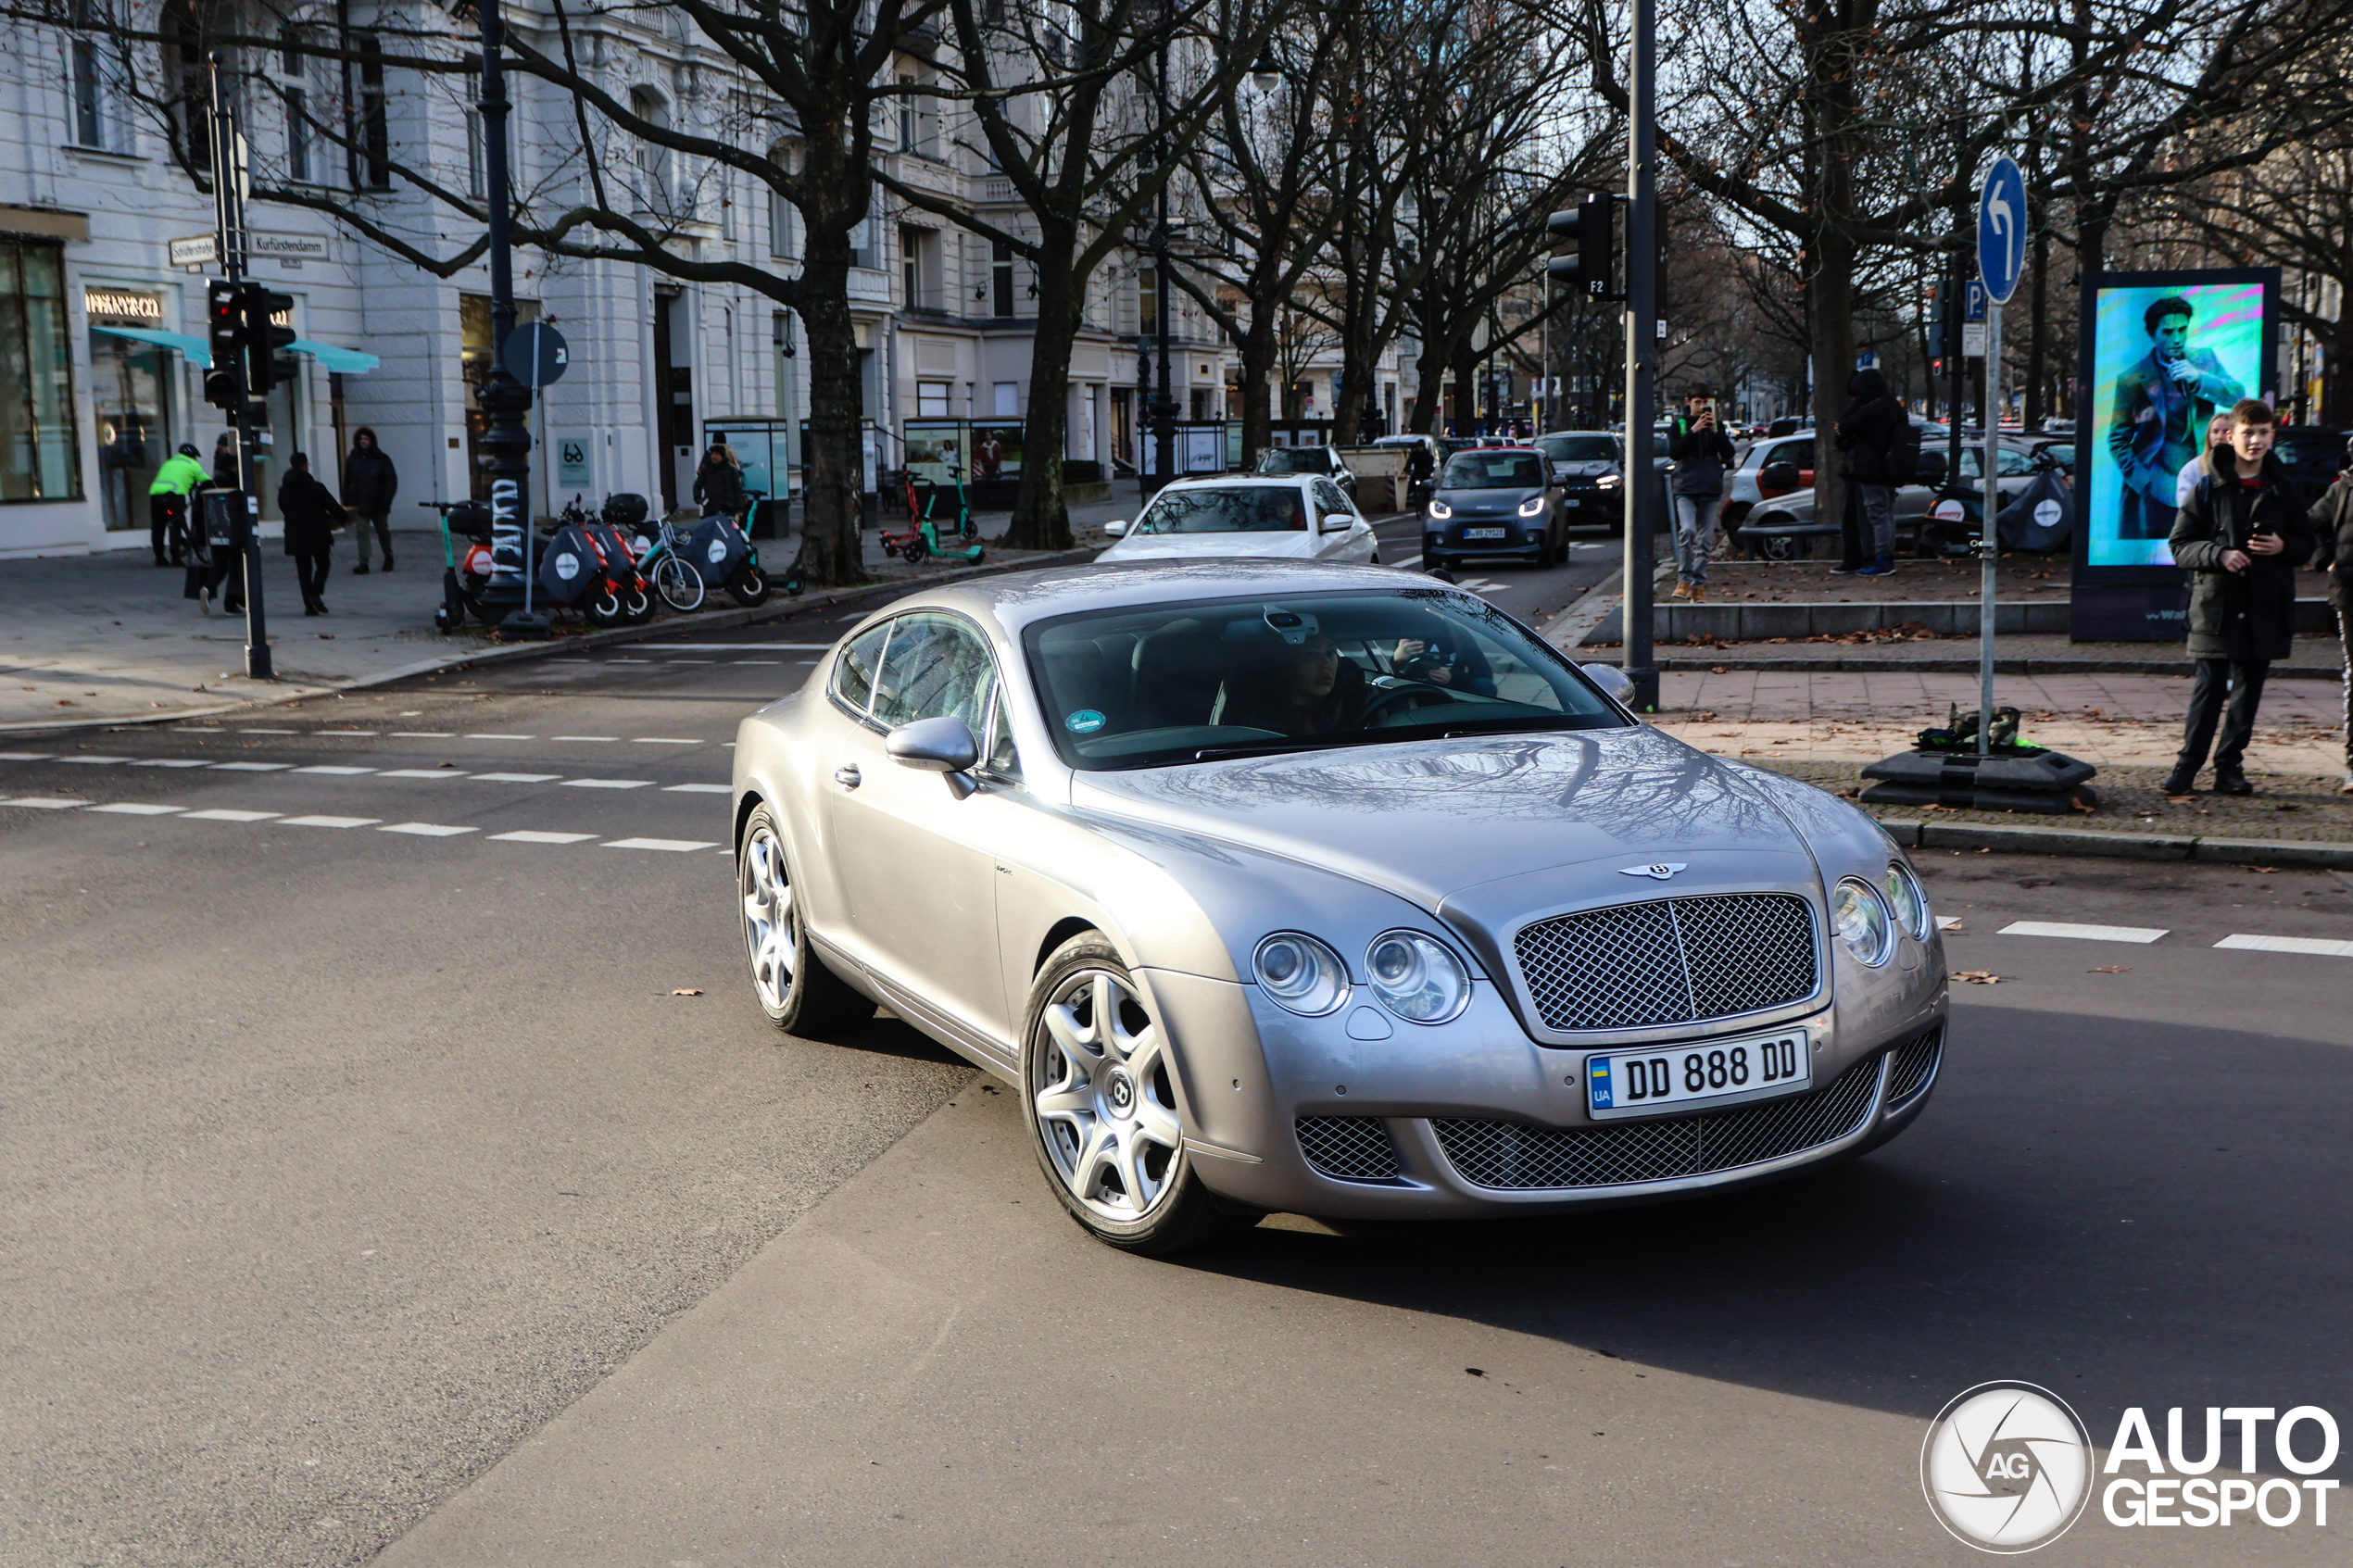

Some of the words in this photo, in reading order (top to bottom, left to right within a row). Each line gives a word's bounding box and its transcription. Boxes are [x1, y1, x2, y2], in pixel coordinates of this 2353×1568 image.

[256, 236, 321, 253] Kurfürstendamm
[1591, 281, 1604, 293] F2
[1969, 285, 1982, 315] P
[1080, 713, 1090, 721] 4
[1626, 1058, 1669, 1099] DD
[1684, 1047, 1748, 1092] 888
[1761, 1039, 1796, 1081] DD
[1594, 1089, 1610, 1102] UA
